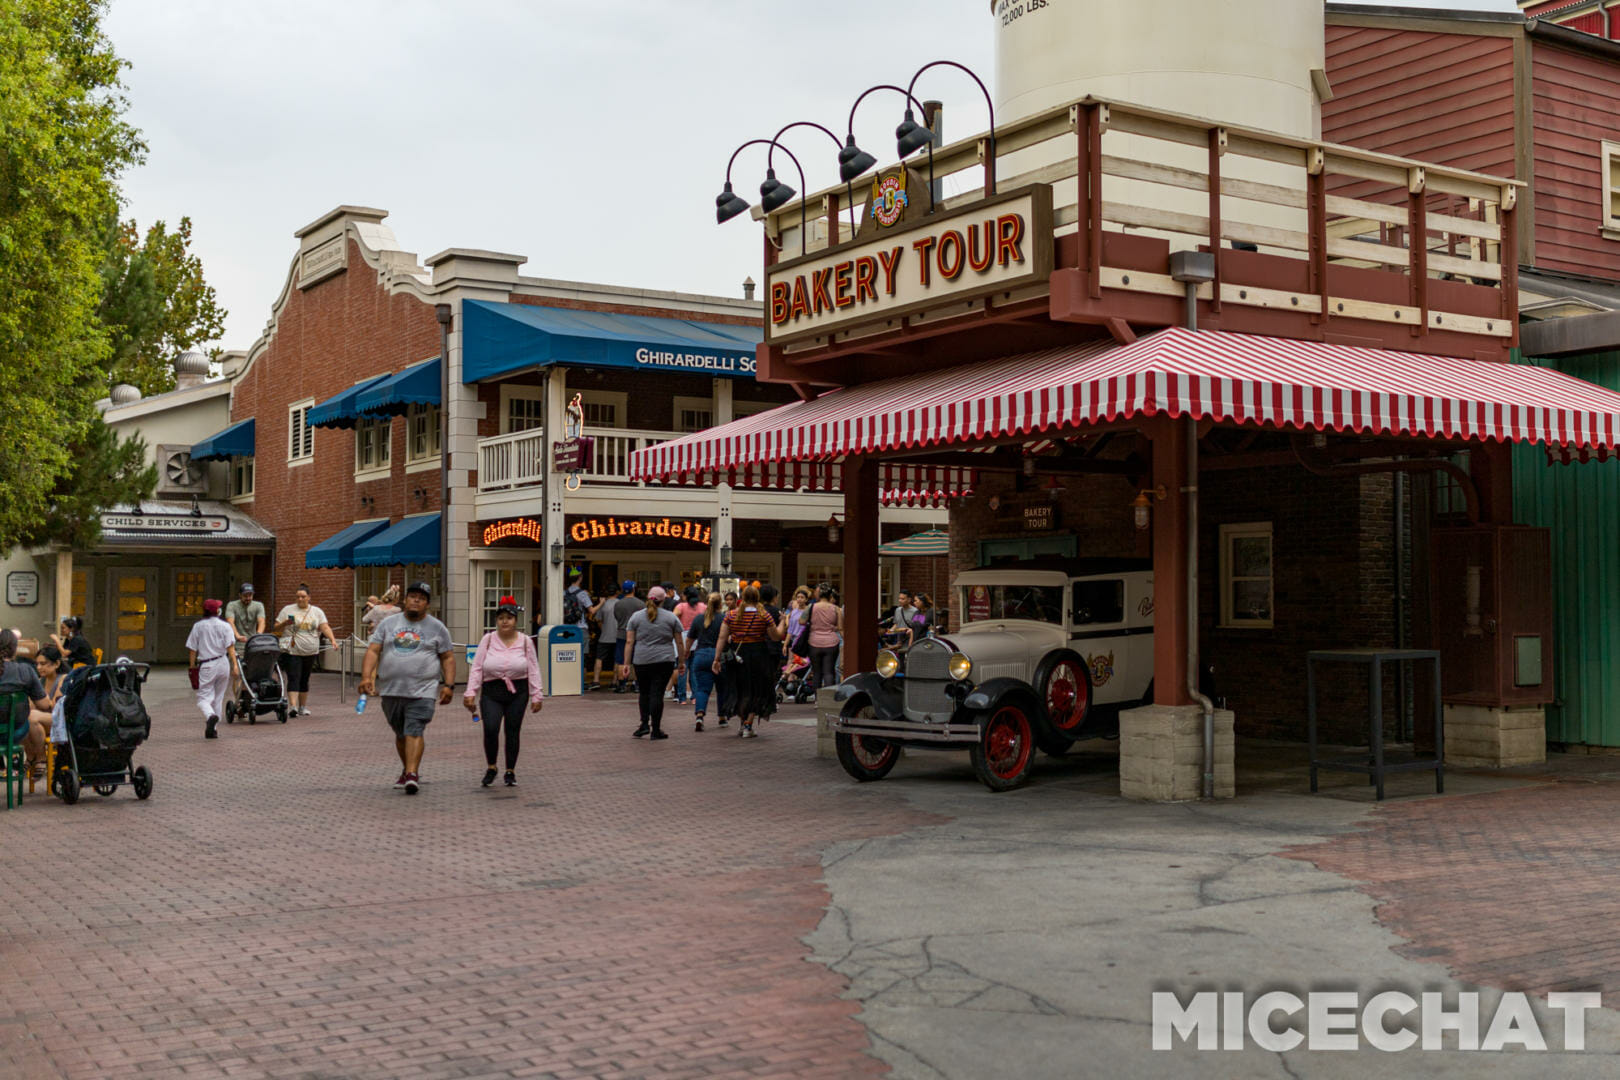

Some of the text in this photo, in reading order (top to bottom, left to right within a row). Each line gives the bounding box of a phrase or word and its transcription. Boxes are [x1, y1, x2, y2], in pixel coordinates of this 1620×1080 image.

[771, 213, 1025, 325] BAKERY TOUR
[635, 348, 735, 370] GHIRARDELLI
[106, 517, 207, 529] CHILD SERVICES
[1024, 507, 1052, 517] BAKERY
[1028, 518, 1047, 528] TOUR
[484, 518, 541, 546] Ghirardelli
[571, 517, 711, 545] Ghirardelli
